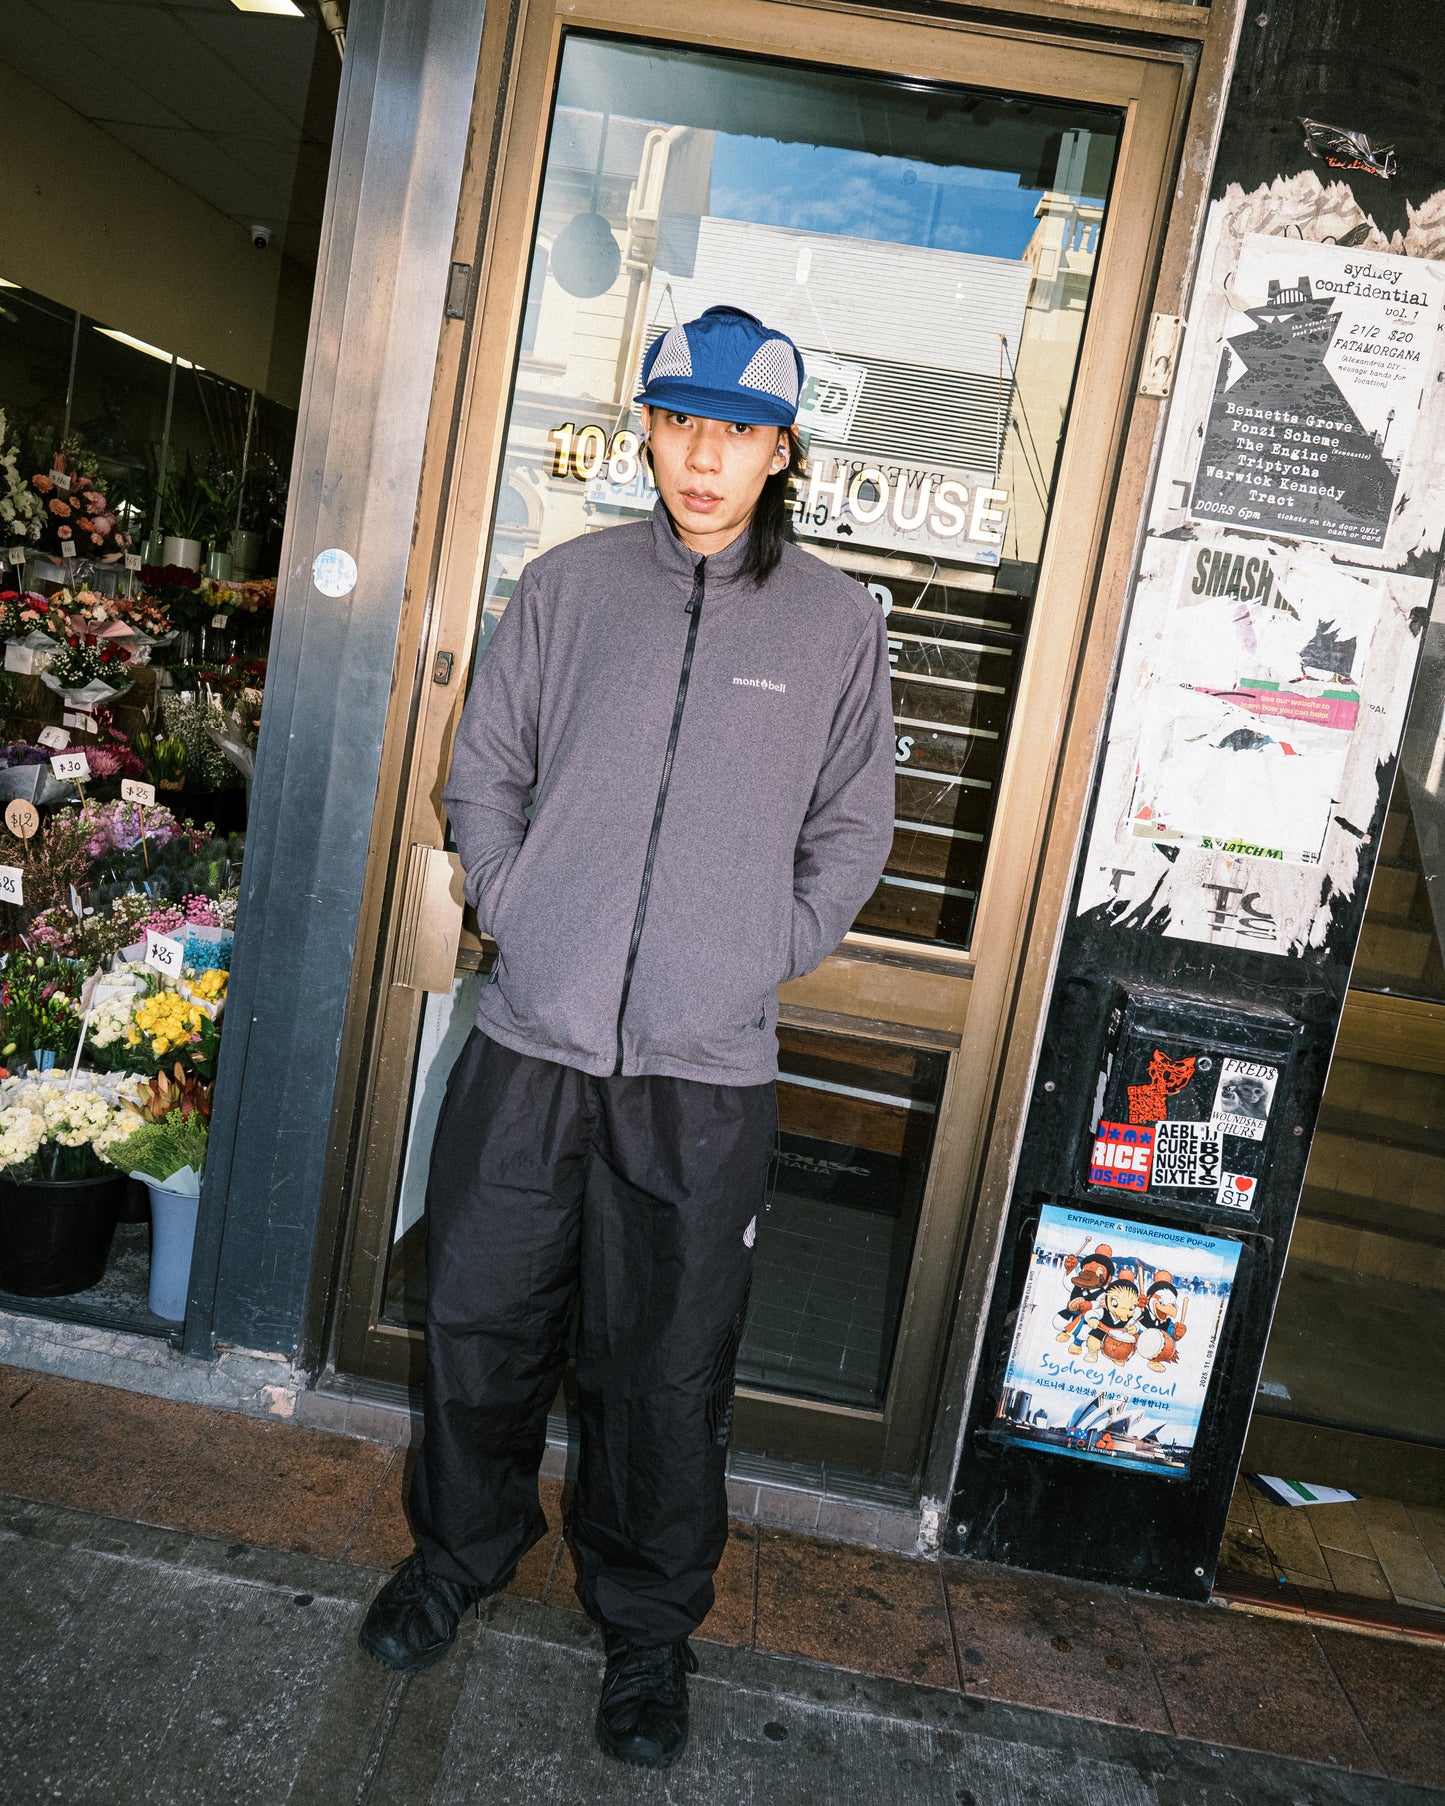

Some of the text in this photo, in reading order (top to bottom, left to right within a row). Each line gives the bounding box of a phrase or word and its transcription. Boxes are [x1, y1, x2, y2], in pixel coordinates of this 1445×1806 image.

[1315, 279, 1429, 307] confidential
[1385, 308, 1419, 320] vol. 1
[1350, 324, 1414, 343] 21/2 $20
[1333, 338, 1421, 362] FATAMORGANA
[1338, 365, 1407, 382] message bands for
[1353, 377, 1389, 388] location)
[1225, 402, 1353, 433] Bennetts Grove
[1231, 420, 1340, 448] Ponzi Scheme
[1236, 437, 1329, 463] The Engine
[1237, 454, 1320, 478] Triptychs
[1206, 465, 1345, 501] Warwick Kennedy
[1249, 490, 1295, 507] Tract
[1194, 500, 1261, 520] DOORS 6pm
[1277, 512, 1381, 535] tickets on the door ONLY
[1327, 528, 1347, 537] cash
[1361, 533, 1382, 542] card
[1192, 547, 1274, 607] SMASH
[1260, 695, 1275, 703] See
[1291, 699, 1321, 709] website
[1322, 702, 1330, 710] to
[1262, 704, 1279, 713] how
[1279, 707, 1294, 715] you
[1309, 710, 1329, 720] help!
[59, 761, 81, 773] $30
[126, 786, 149, 800] $25
[11, 812, 33, 828] $12
[152, 943, 175, 965] $25
[1224, 1059, 1276, 1080] FRED$
[1158, 1124, 1198, 1139] AEBL
[1216, 1122, 1257, 1138] CHUR$
[1091, 1140, 1151, 1172] RICE
[1157, 1140, 1198, 1154] CURE
[1156, 1154, 1197, 1169] NUSH
[1198, 1141, 1219, 1186] BOYS
[1154, 1169, 1196, 1185] SIXTE
[1225, 1174, 1235, 1189] I
[1222, 1190, 1249, 1207] SP
[1067, 1214, 1115, 1230] ENTRIPAPER
[1124, 1225, 1185, 1243] 108WAREHOUSE
[1187, 1237, 1216, 1249] POP-UP
[1035, 1378, 1066, 1391] 시드니에
[1068, 1385, 1097, 1399] 오신것을
